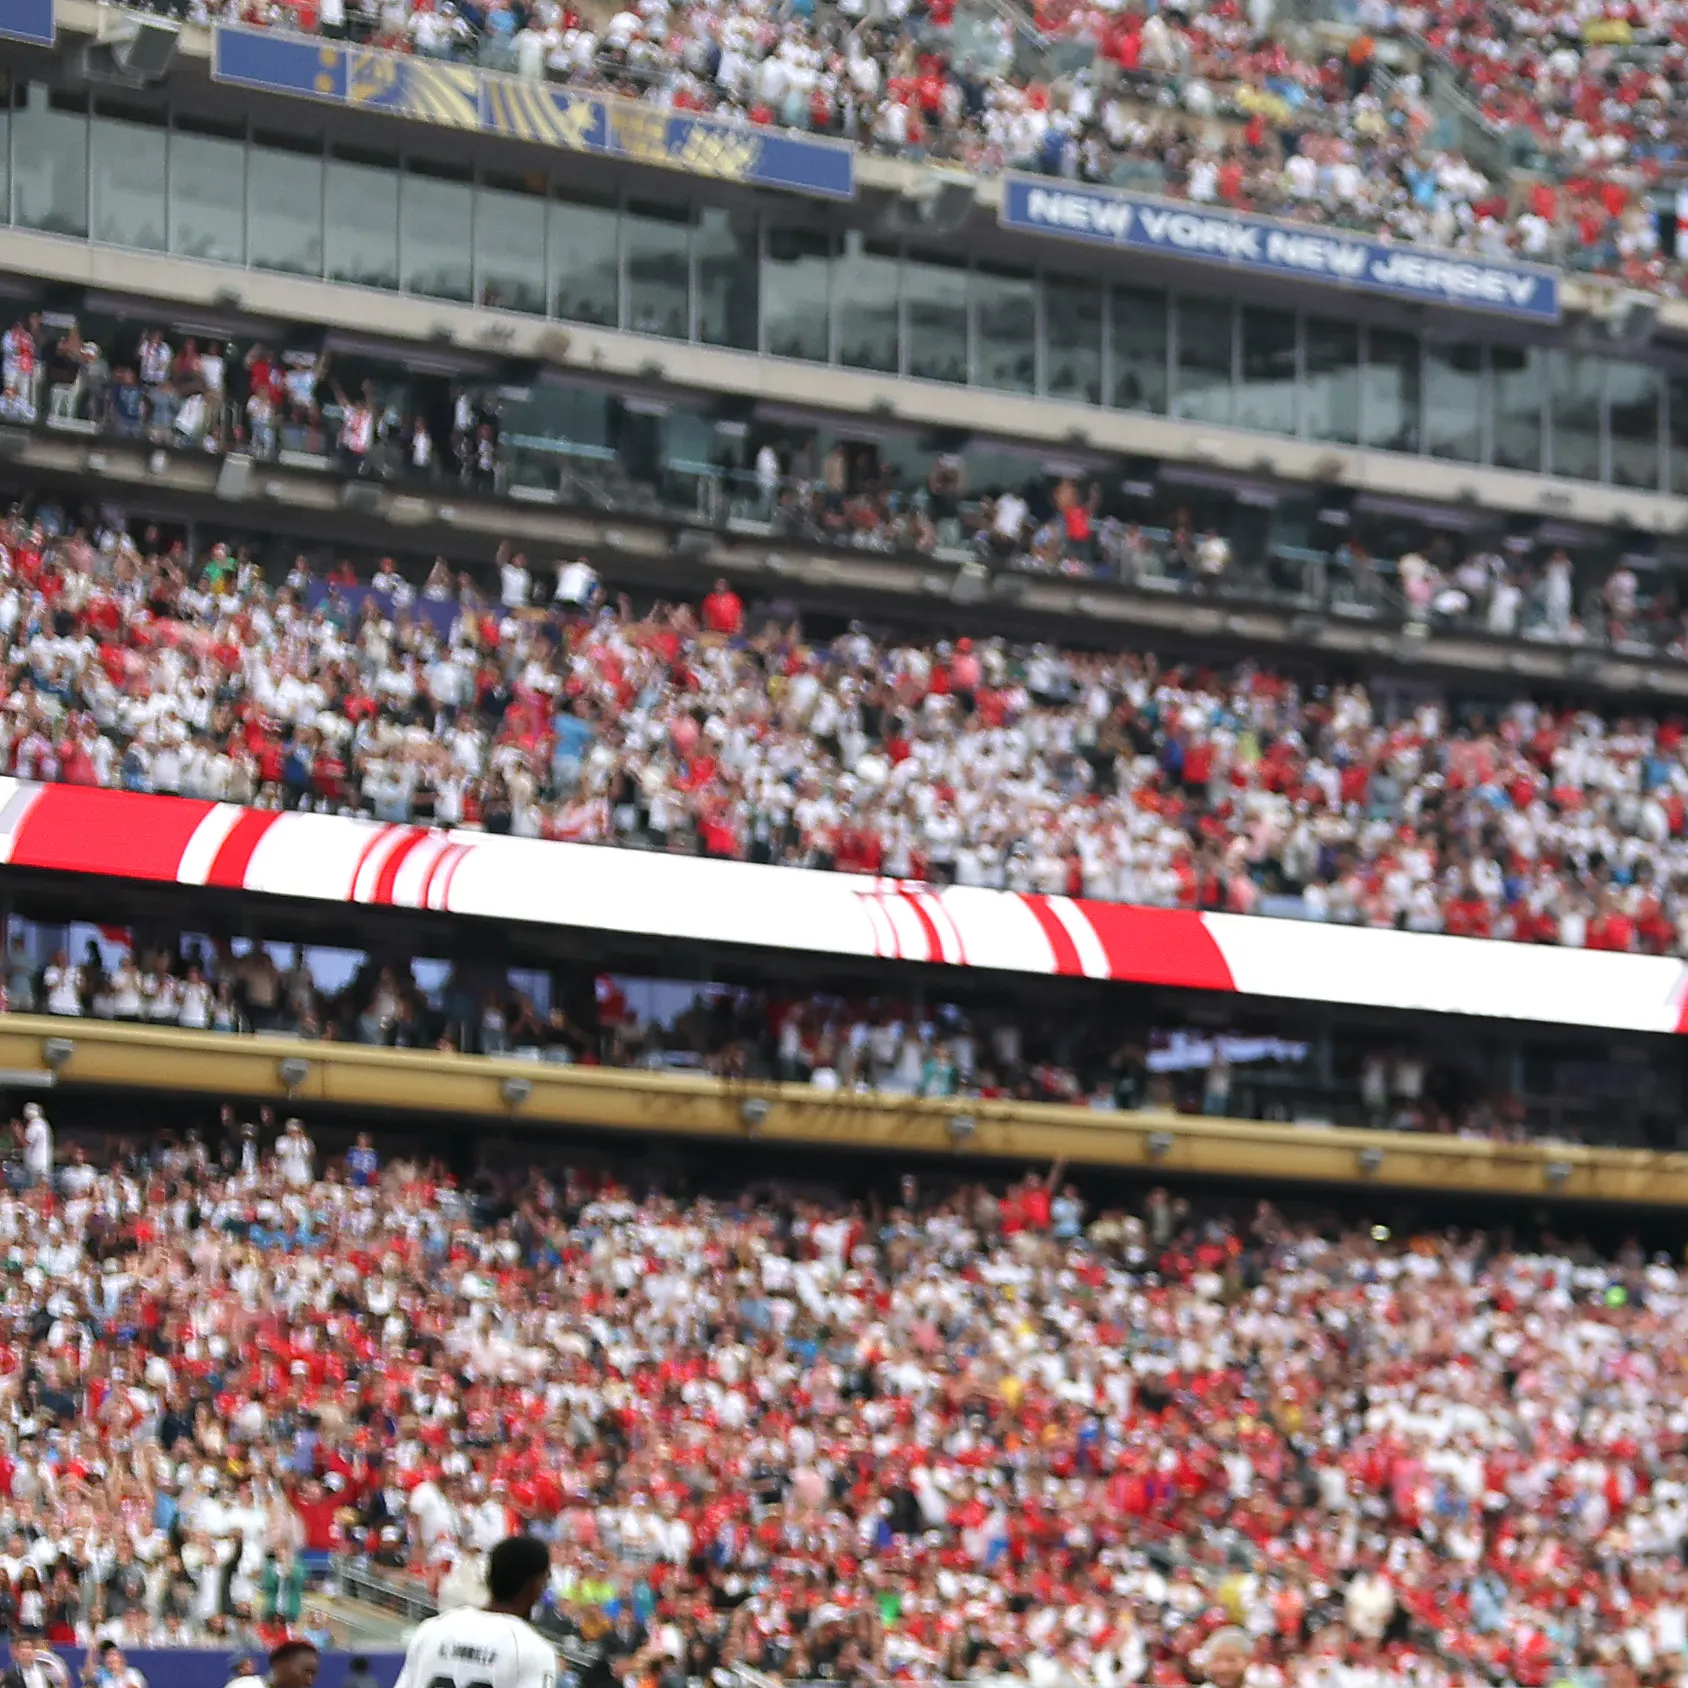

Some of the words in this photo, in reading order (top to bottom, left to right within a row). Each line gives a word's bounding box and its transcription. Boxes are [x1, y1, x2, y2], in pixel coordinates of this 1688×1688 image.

[1028, 189, 1131, 238] NEW
[1139, 208, 1260, 260] YORK
[1266, 231, 1367, 278] NEW
[1370, 254, 1537, 303] JERSEY
